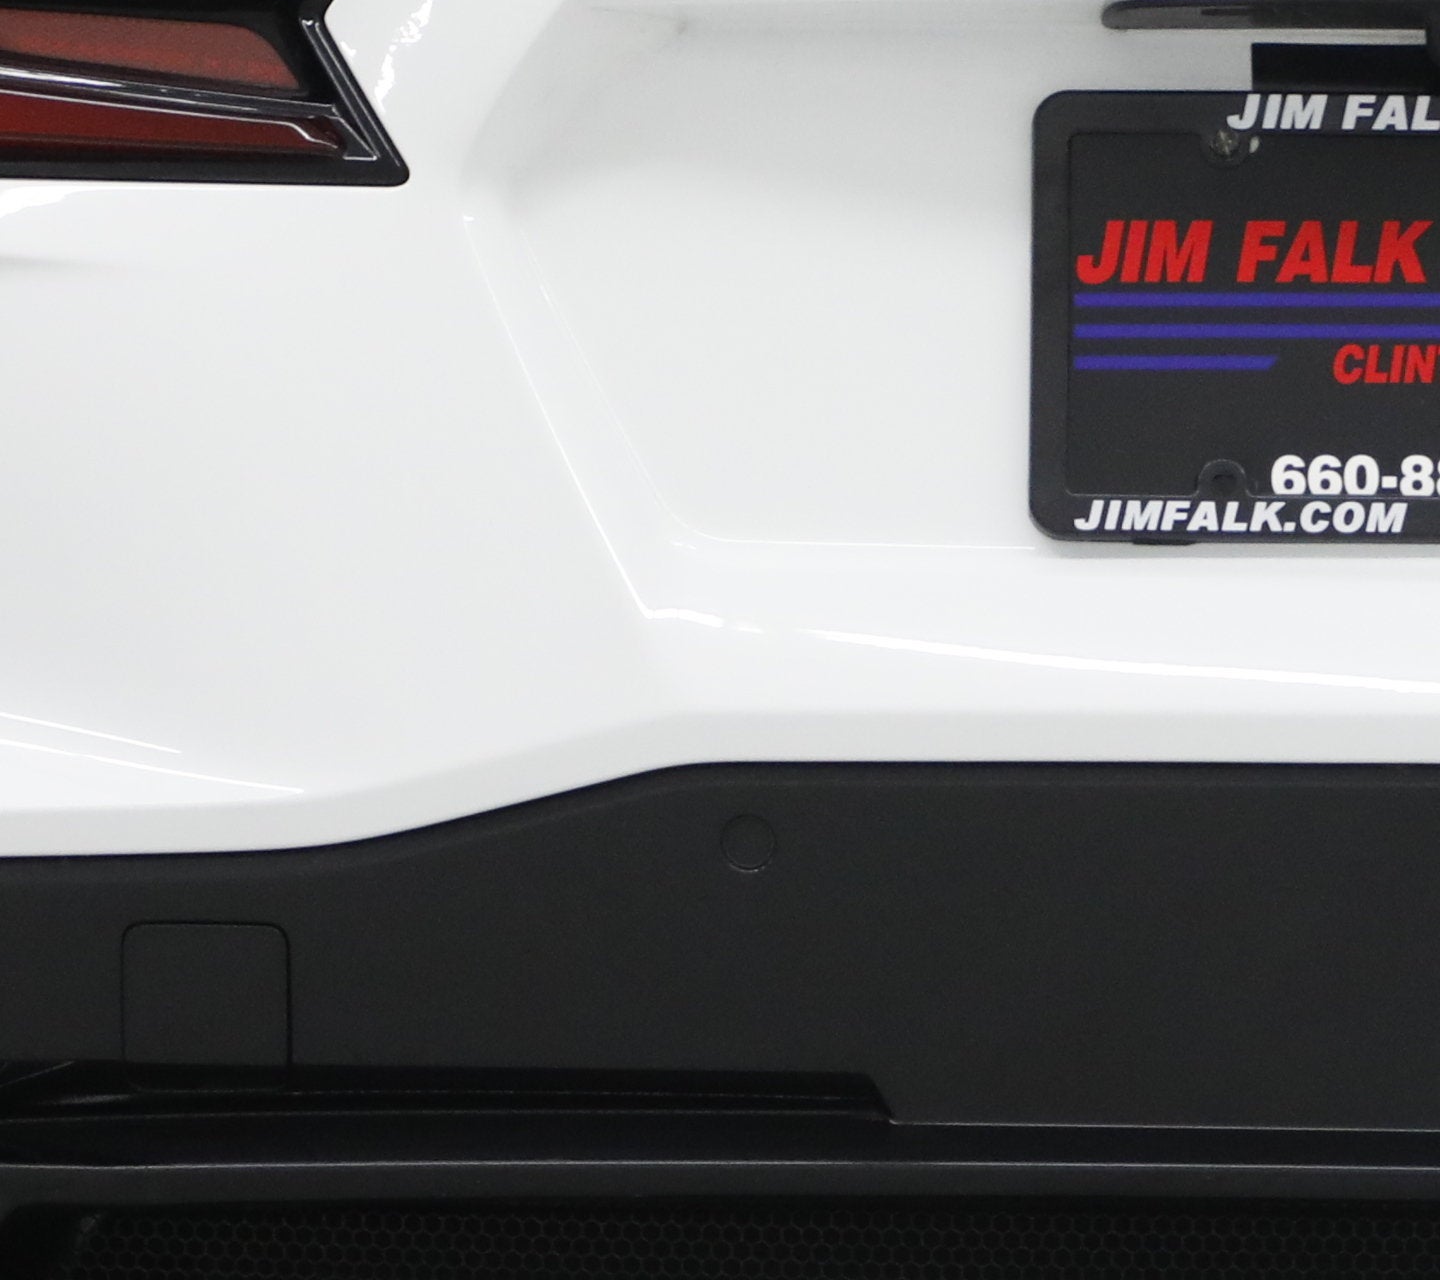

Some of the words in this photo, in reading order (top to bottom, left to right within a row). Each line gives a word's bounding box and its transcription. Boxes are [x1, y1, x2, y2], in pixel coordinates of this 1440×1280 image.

[1226, 94, 1328, 132] JIM
[1076, 219, 1212, 284] JIM
[1236, 219, 1434, 285] FALK
[1074, 500, 1408, 534] JIMFALK.COM
